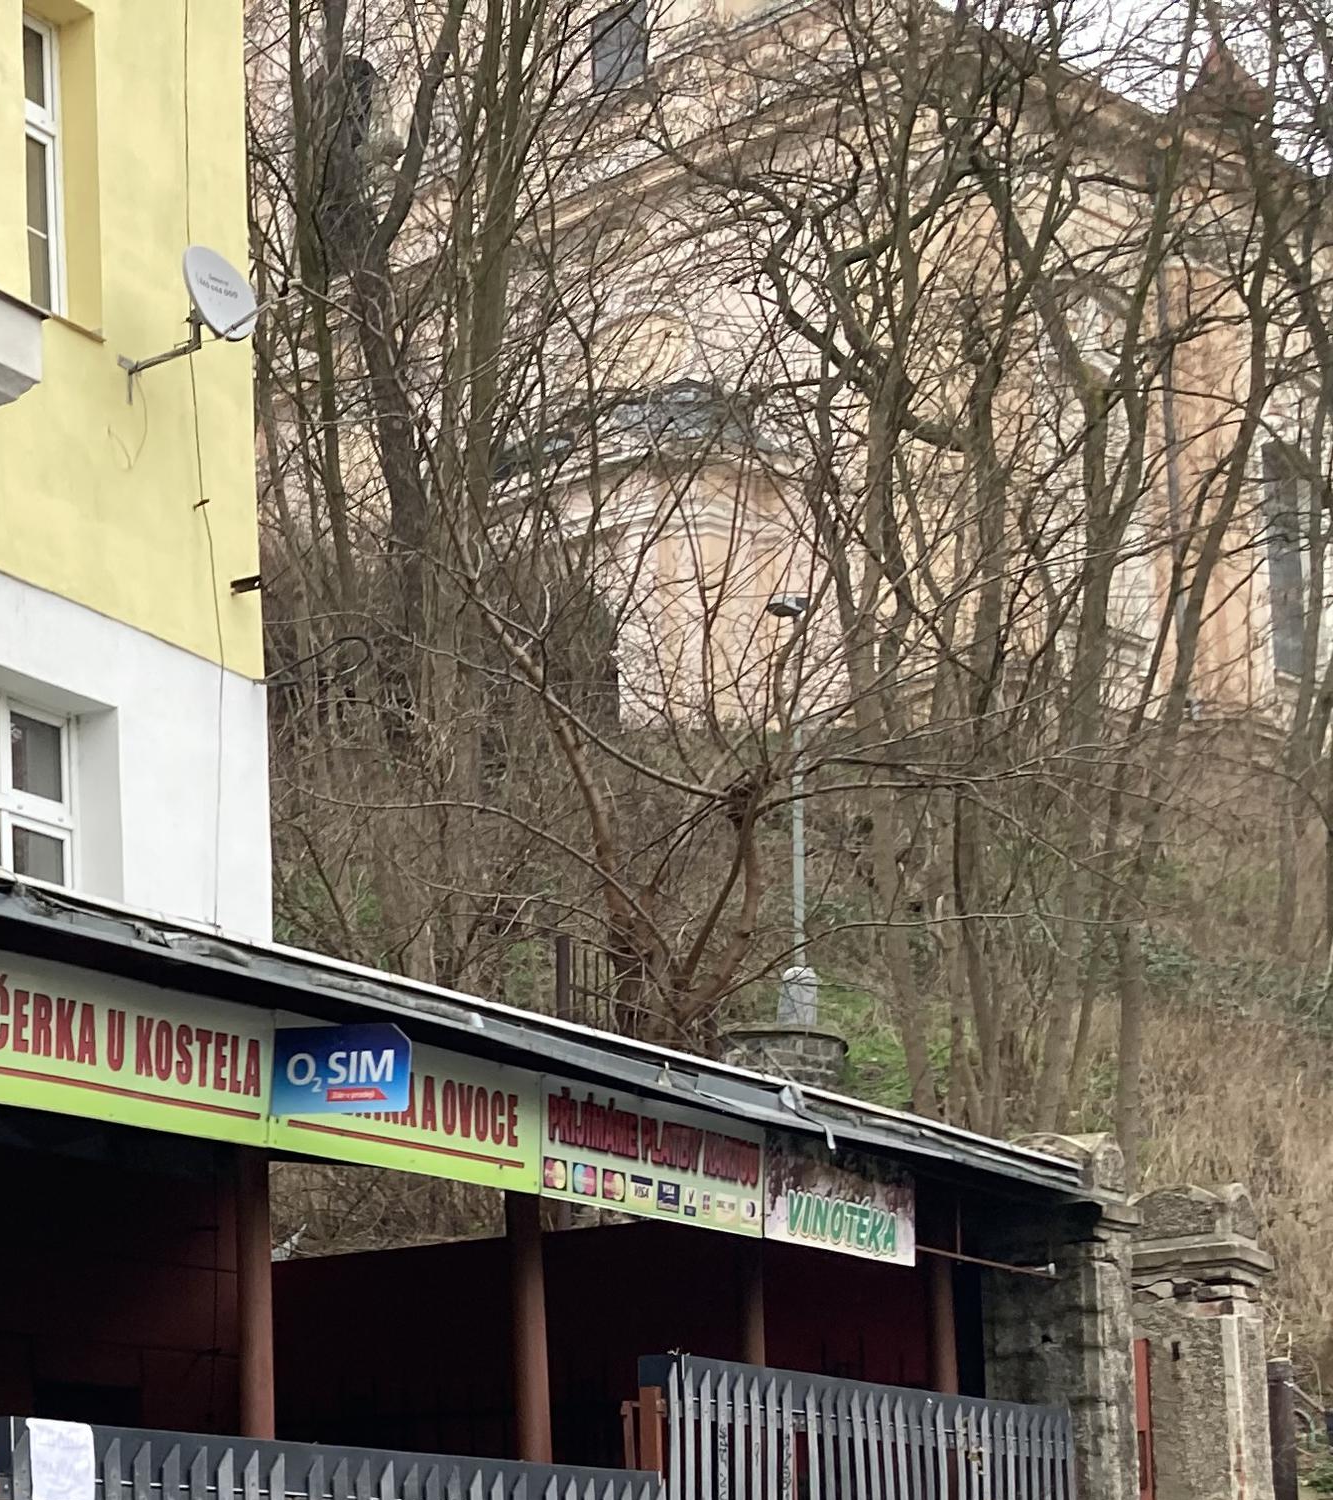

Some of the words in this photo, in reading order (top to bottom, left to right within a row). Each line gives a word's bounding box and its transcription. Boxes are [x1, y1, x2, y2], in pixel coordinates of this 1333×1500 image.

[107, 1008, 126, 1072] U
[135, 1015, 261, 1097] KOSTELA
[327, 1049, 395, 1084] SIM
[421, 1076, 437, 1131] A
[442, 1079, 518, 1147] OVOCE
[641, 1116, 704, 1173] PLATBY
[634, 1185, 649, 1198] VISA
[788, 1189, 897, 1257] VINOTÉKA
